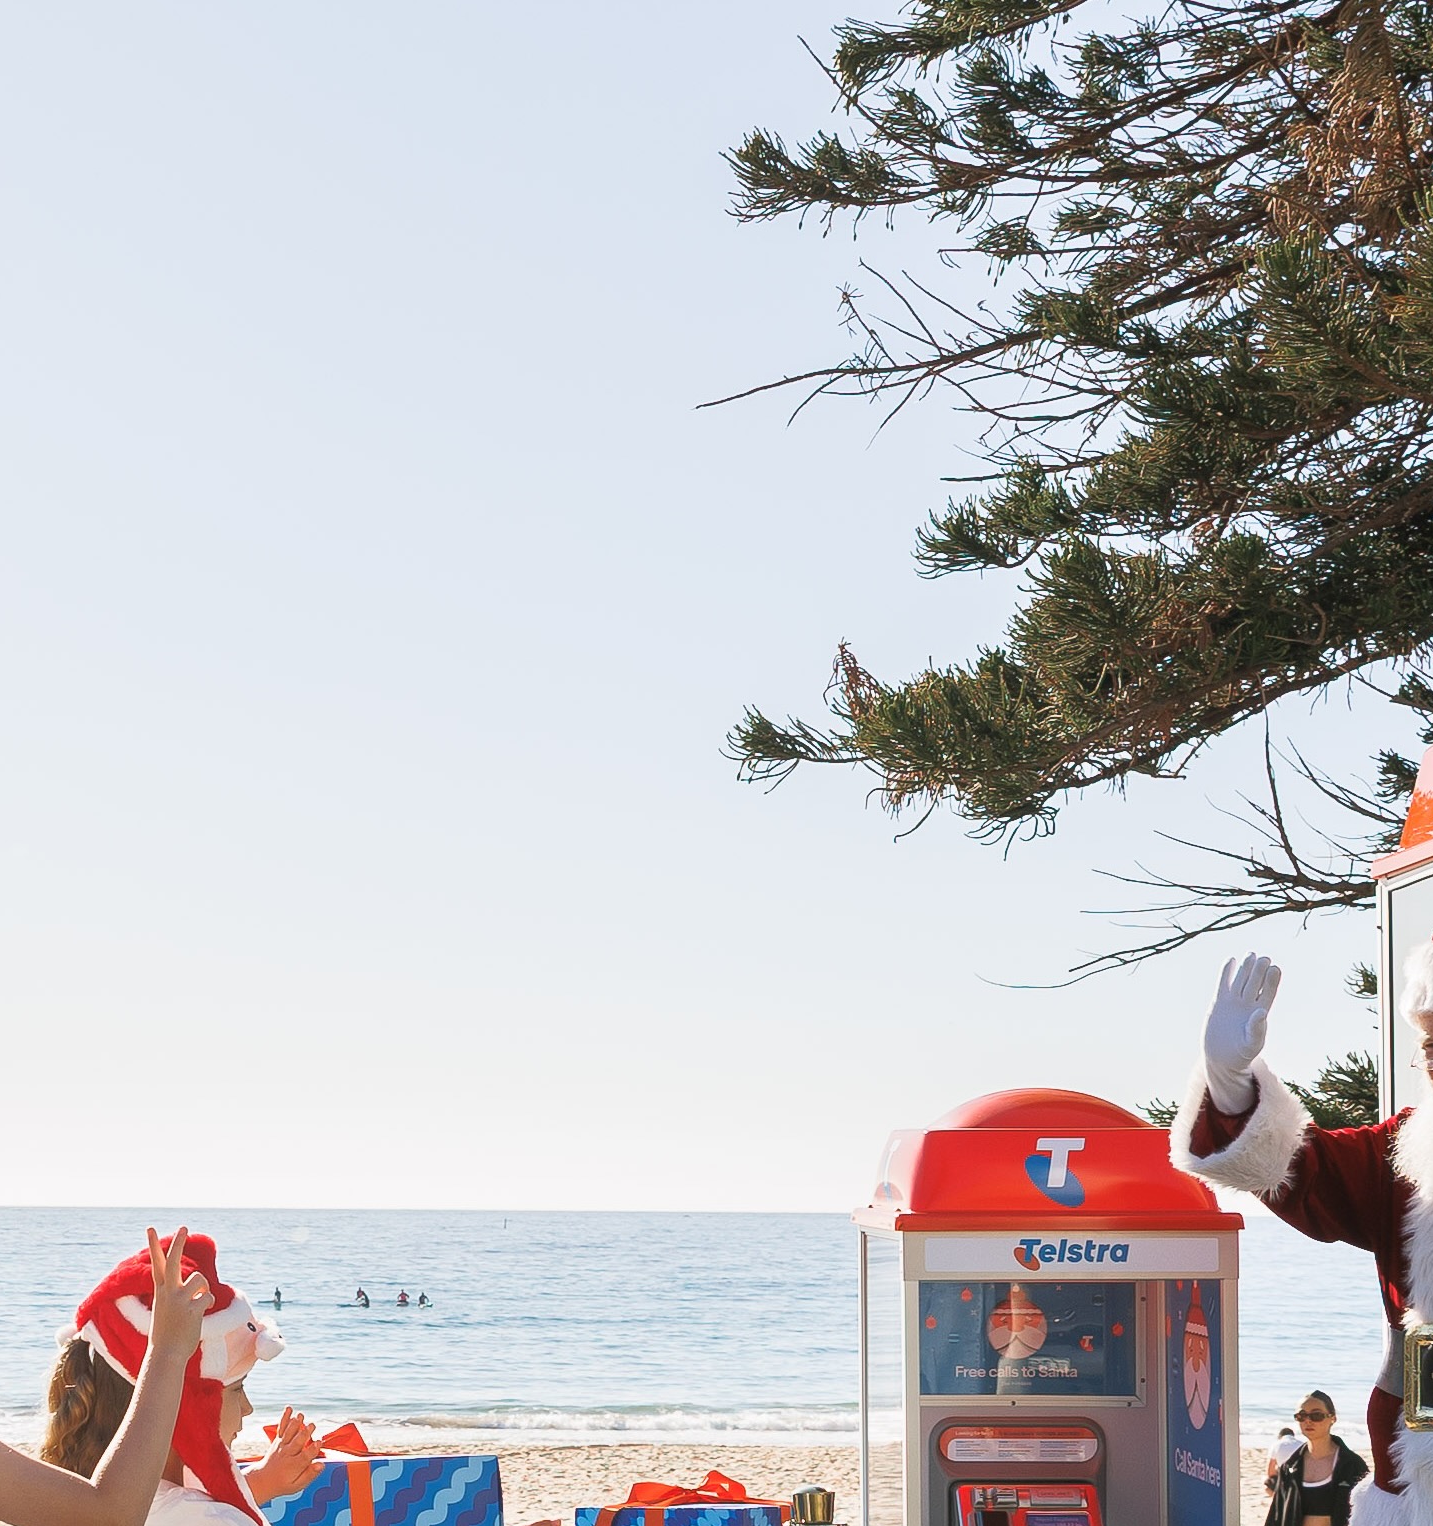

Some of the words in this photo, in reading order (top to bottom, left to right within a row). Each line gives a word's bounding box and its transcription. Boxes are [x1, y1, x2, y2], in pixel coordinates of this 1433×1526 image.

[1036, 1137, 1086, 1188] T
[1019, 1239, 1129, 1262] Telstra
[955, 1366, 986, 1378] Free
[988, 1366, 1019, 1378] calls
[1021, 1366, 1036, 1378] to
[1038, 1365, 1078, 1378] Santa
[1174, 1447, 1187, 1474] Call
[1187, 1451, 1206, 1481] Santa
[1206, 1459, 1221, 1487] here
